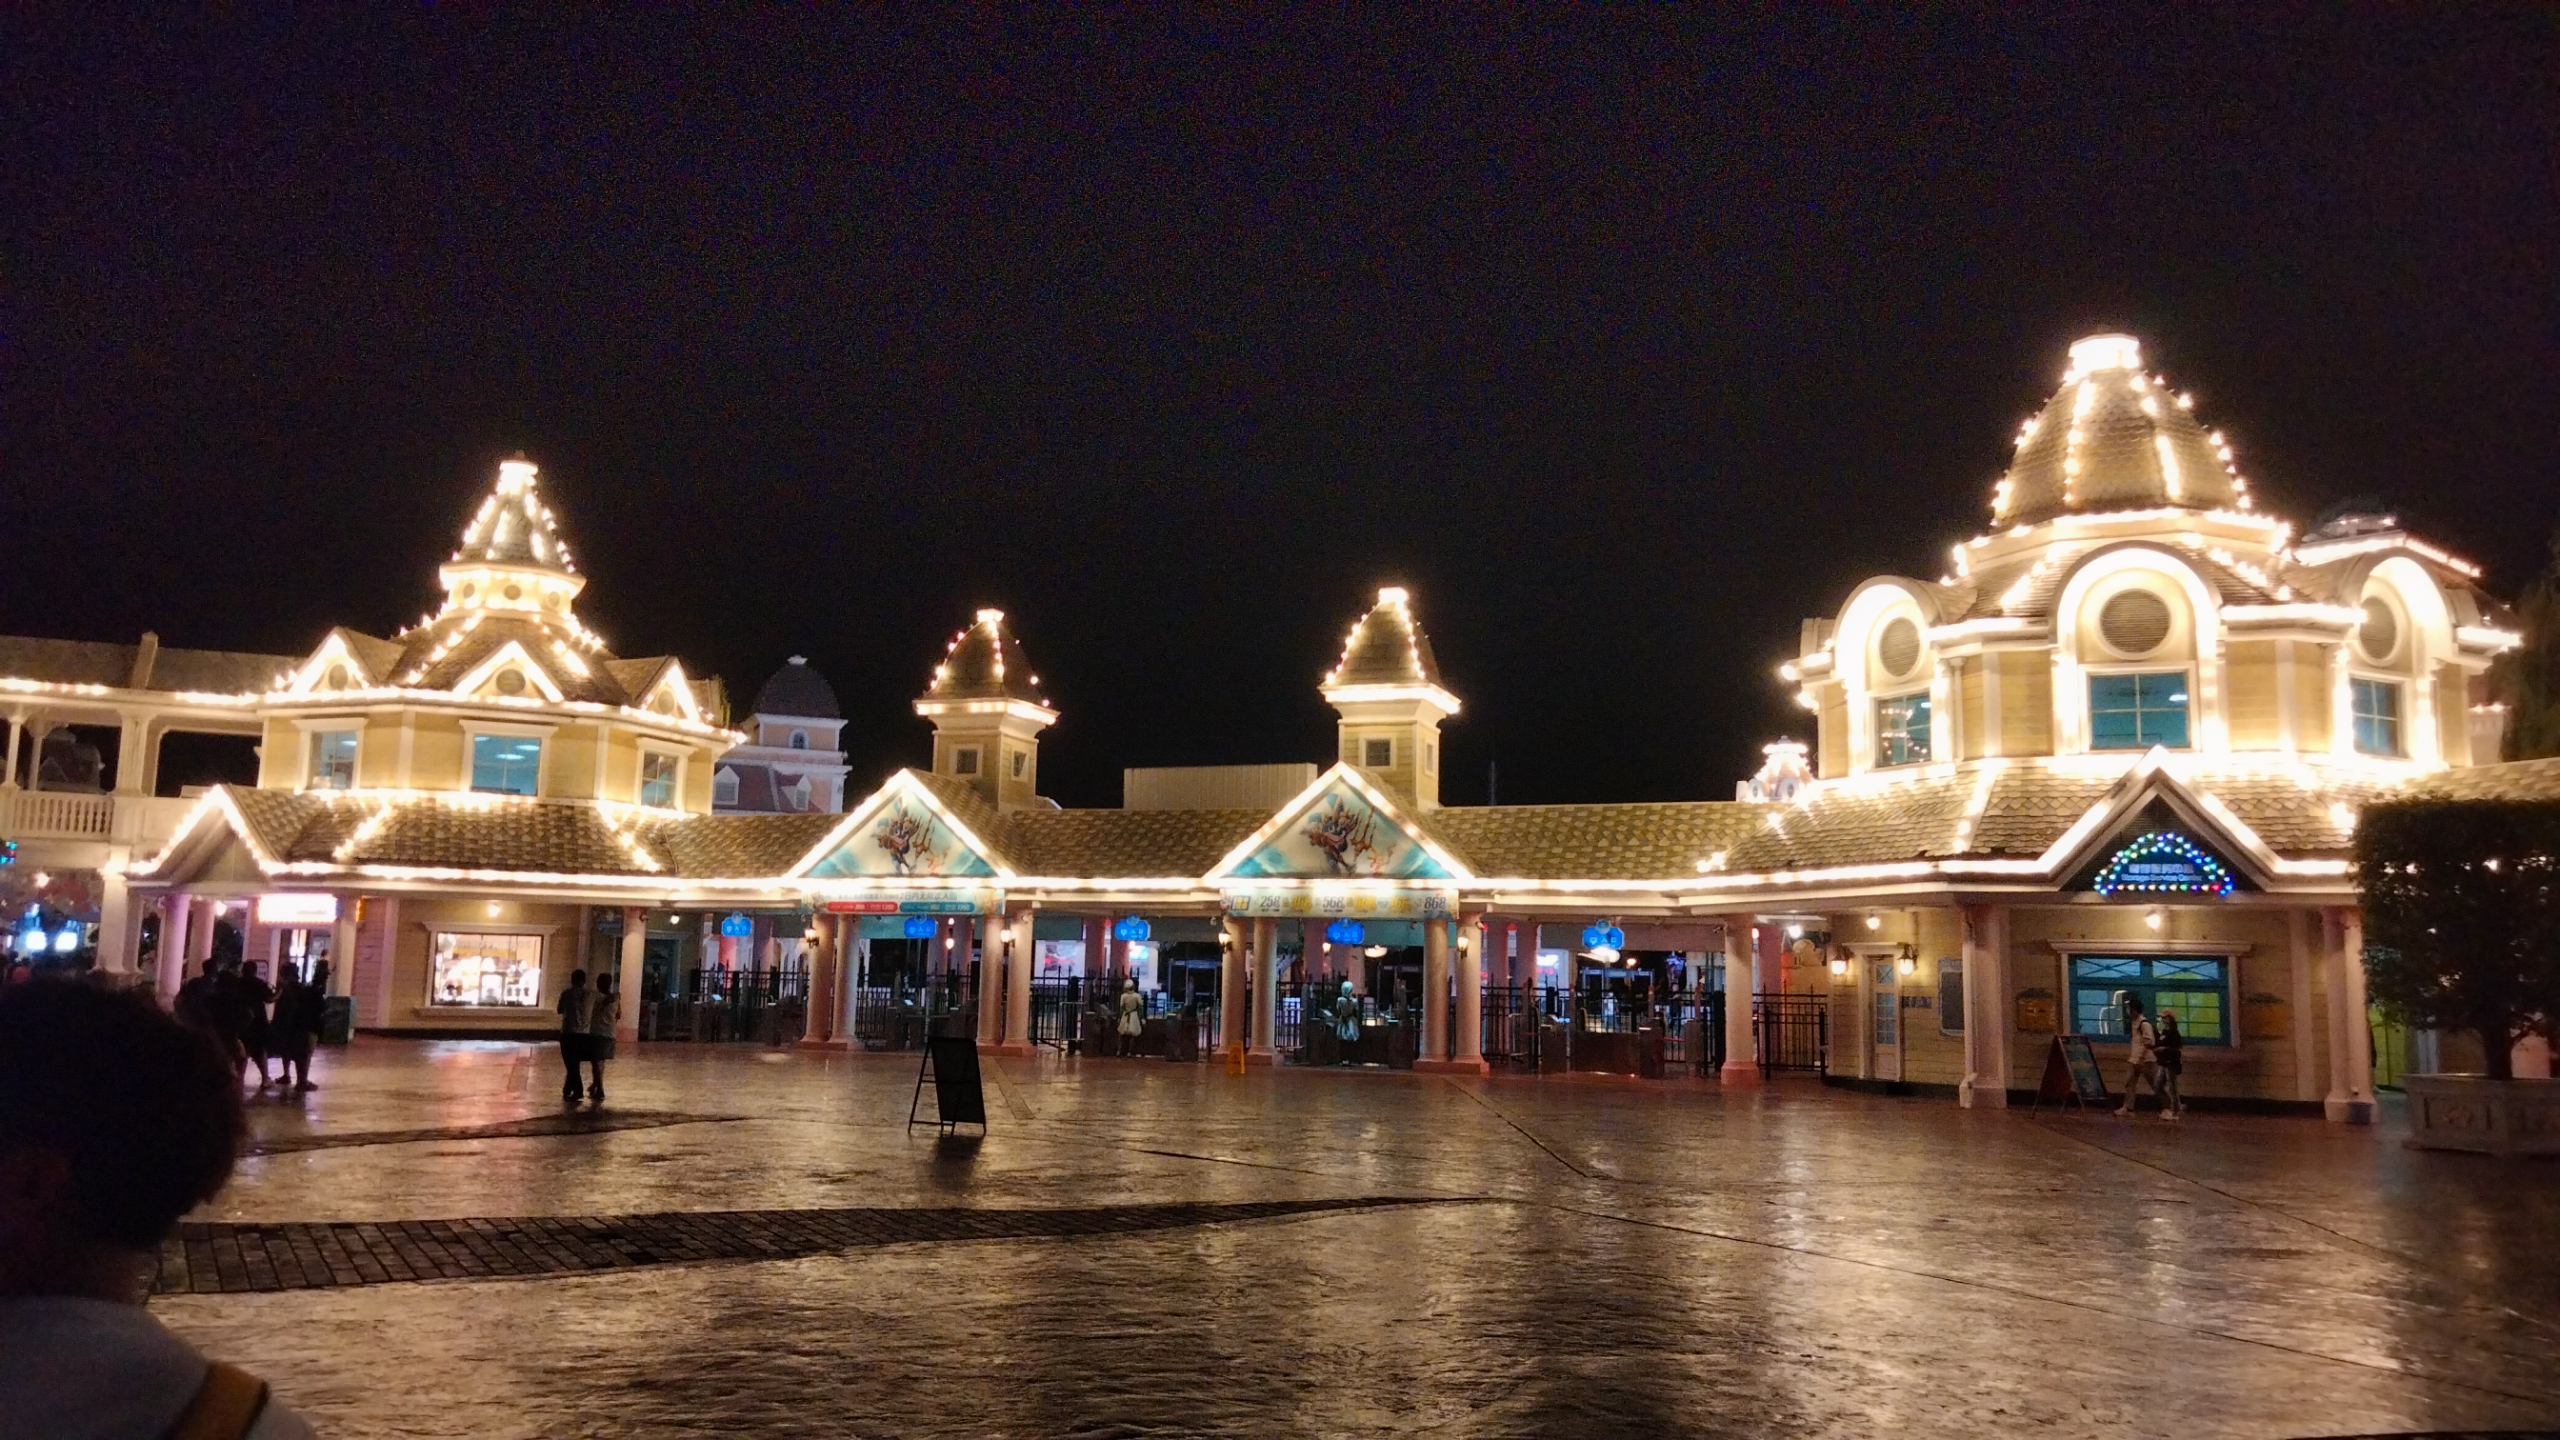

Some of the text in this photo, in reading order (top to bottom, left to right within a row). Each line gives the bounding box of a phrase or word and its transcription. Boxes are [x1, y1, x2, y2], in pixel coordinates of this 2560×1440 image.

[1260, 896, 1280, 908] 258
[1323, 896, 1343, 908] 568
[1424, 896, 1446, 909] 868
